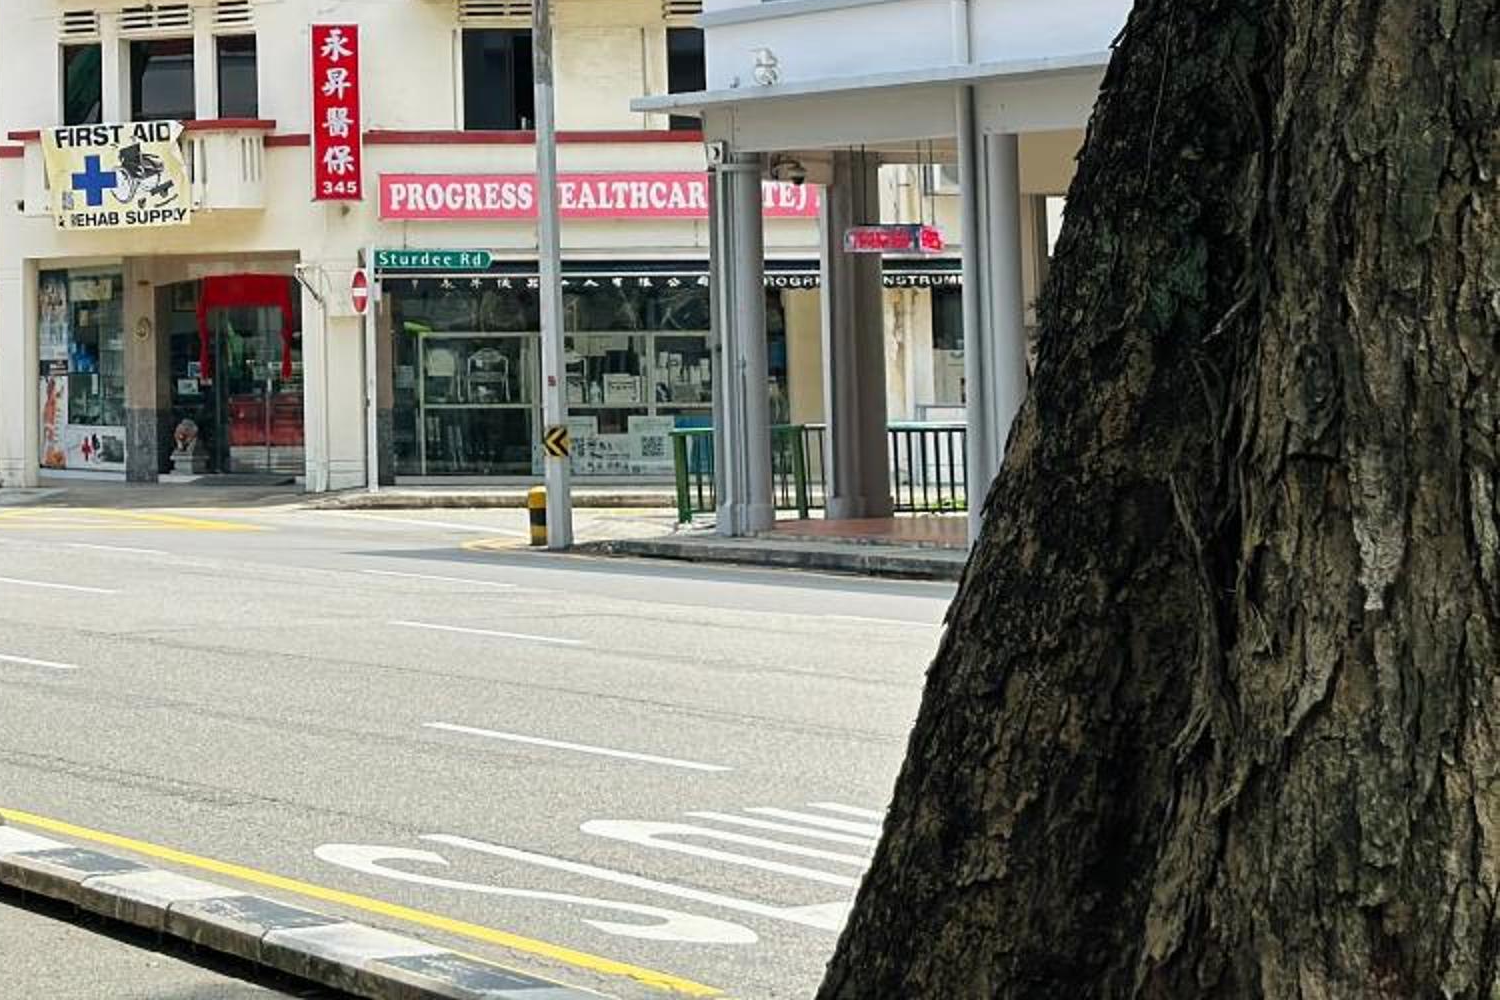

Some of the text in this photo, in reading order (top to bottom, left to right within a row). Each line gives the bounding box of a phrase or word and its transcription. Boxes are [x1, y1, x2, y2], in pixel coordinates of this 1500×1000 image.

[55, 122, 171, 149] FIRST AID
[323, 181, 357, 194] 345
[388, 182, 533, 211] PROGRESS
[557, 180, 708, 211] EALTHCAR
[379, 251, 482, 266] Sturdee Rd
[882, 275, 963, 286] NSTRUM
